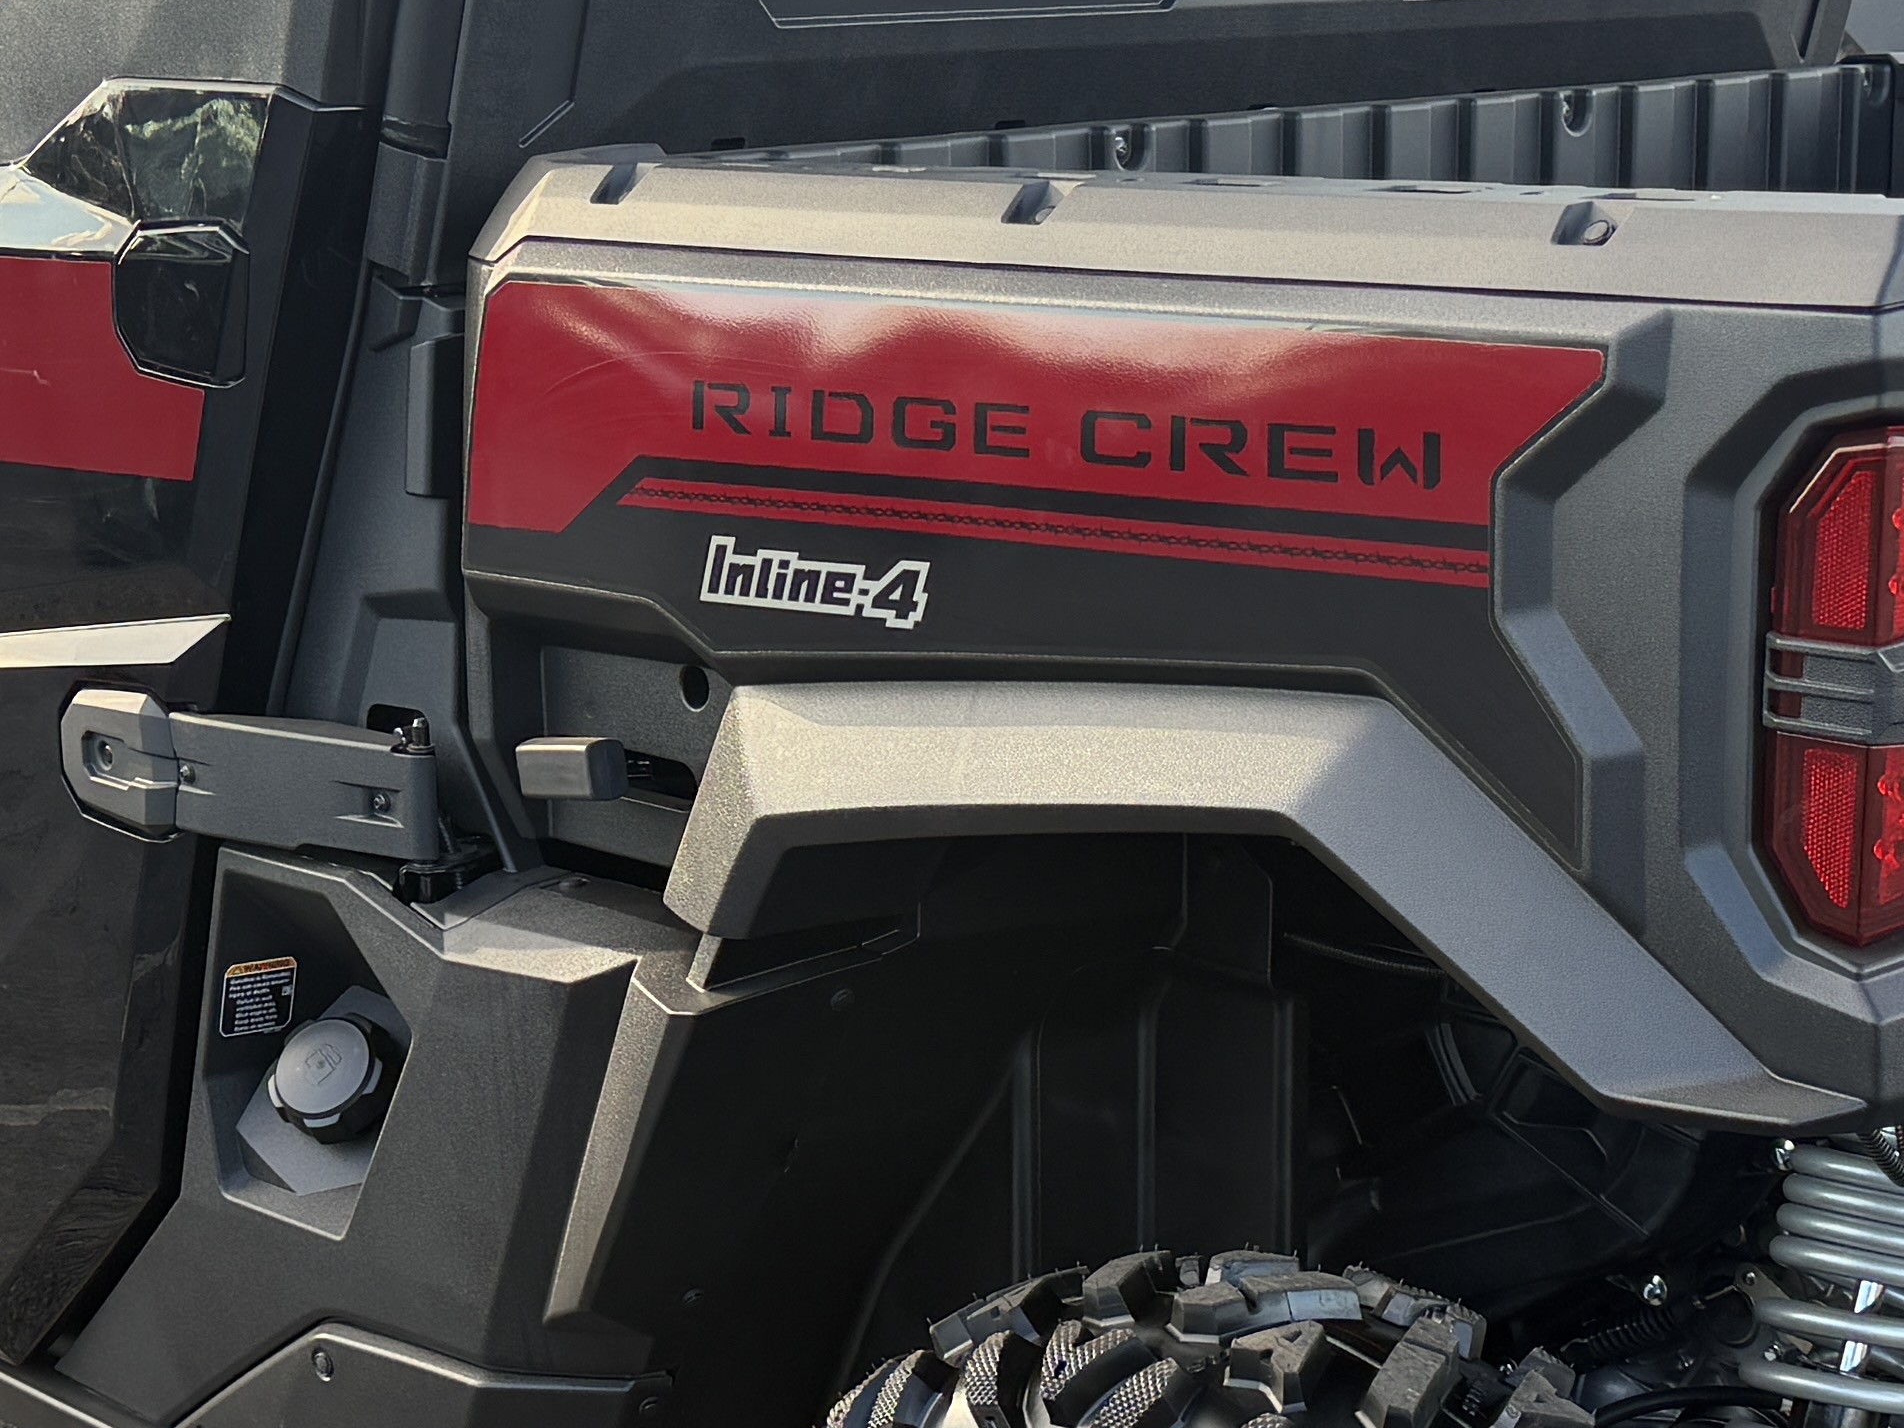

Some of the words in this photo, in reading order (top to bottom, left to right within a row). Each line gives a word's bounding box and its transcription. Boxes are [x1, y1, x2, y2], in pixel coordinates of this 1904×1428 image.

[689, 379, 1032, 460] RIDGE
[1078, 410, 1442, 491] CREW
[701, 533, 928, 628] Inline-4
